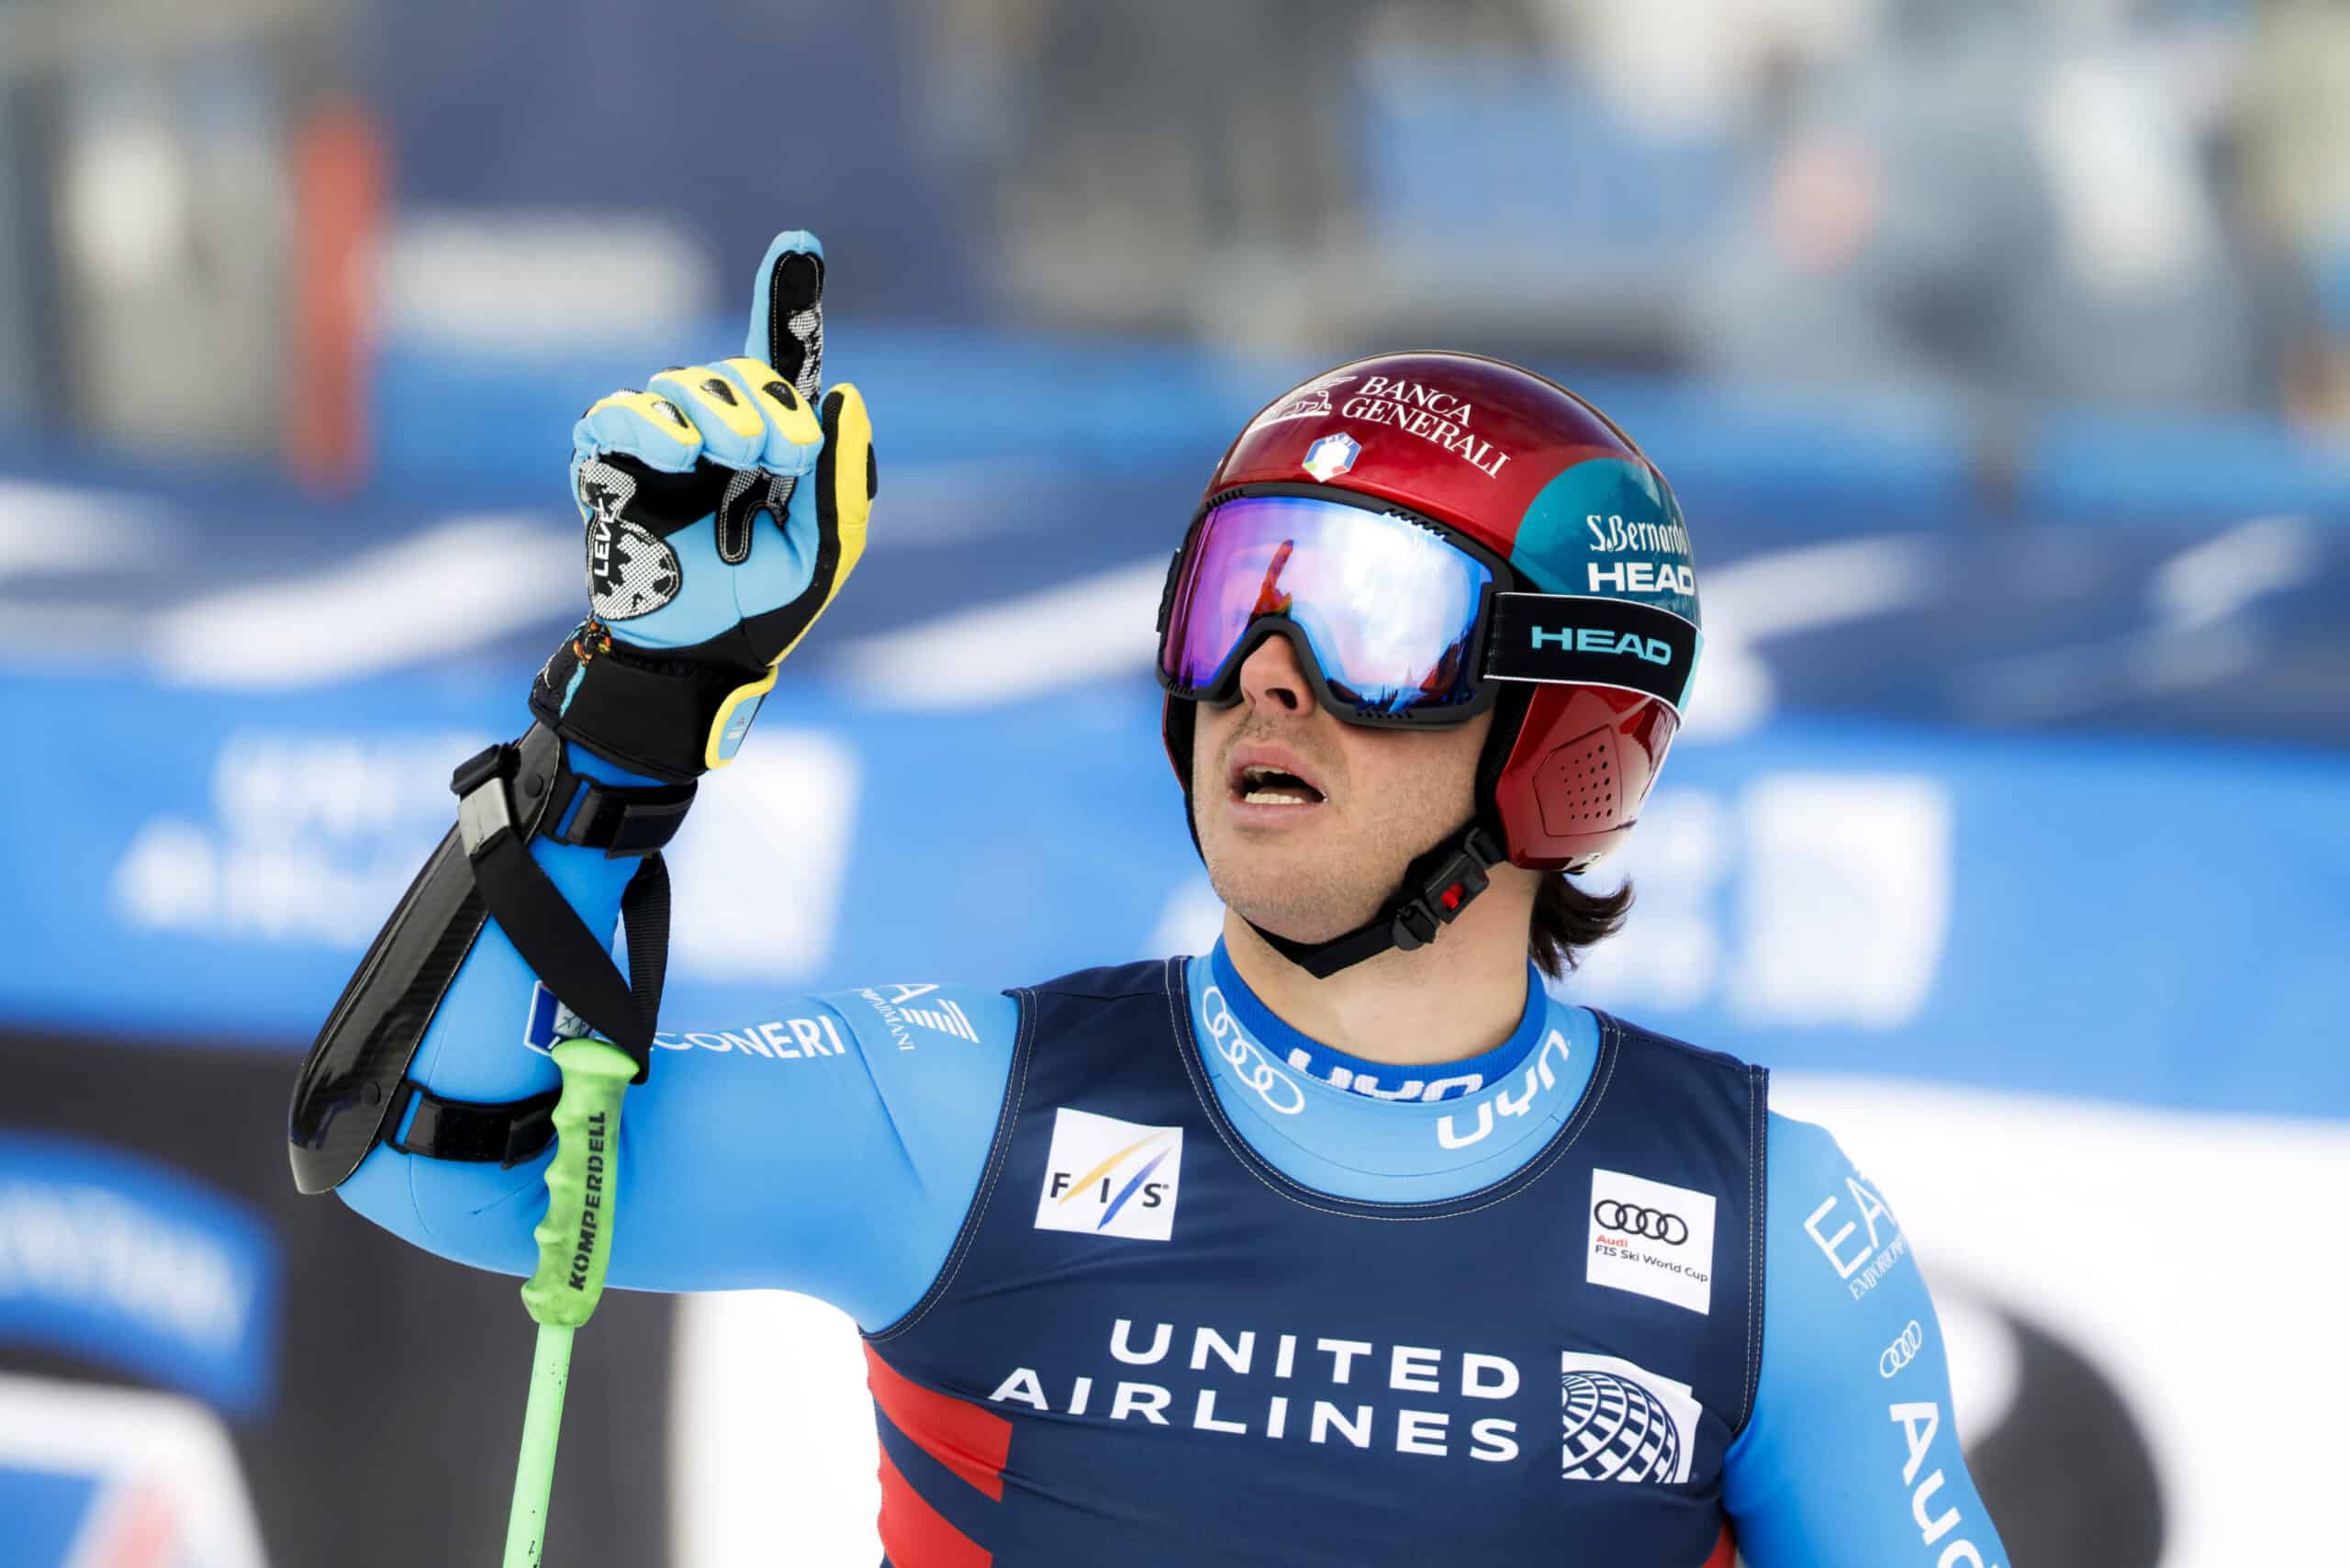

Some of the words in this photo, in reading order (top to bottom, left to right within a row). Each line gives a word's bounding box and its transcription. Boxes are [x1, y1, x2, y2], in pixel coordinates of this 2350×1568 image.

[1356, 375, 1472, 427] BANCA
[1341, 397, 1511, 479] GENERALI
[1587, 562, 1695, 596] HEAD
[1531, 625, 1672, 666] HEAD
[650, 1015, 845, 1058] CONERI
[568, 1111, 606, 1292] KOMPERDELL
[1595, 1244, 1617, 1257] FIS
[1620, 1249, 1640, 1261] Ski
[1642, 1254, 1682, 1273] World
[1684, 1267, 1709, 1282] Cup
[1596, 1235, 1628, 1248] Audi
[1109, 1318, 1520, 1399] UNITED
[989, 1367, 1519, 1462] AIRLINES
